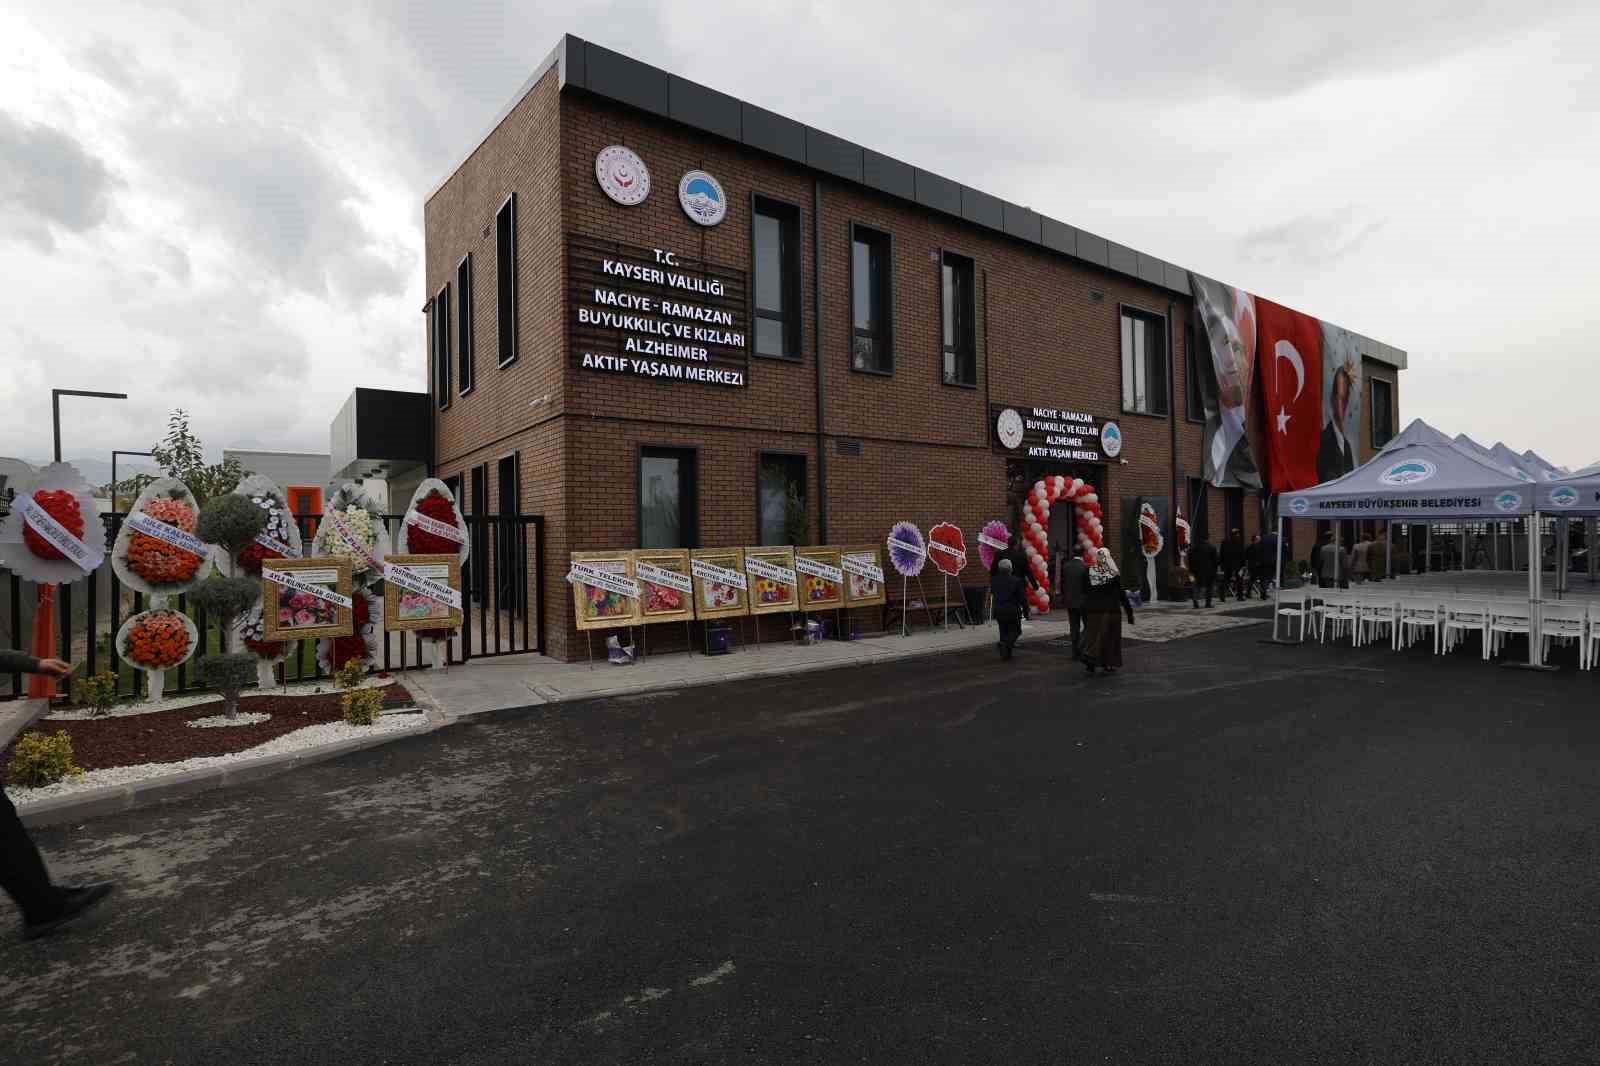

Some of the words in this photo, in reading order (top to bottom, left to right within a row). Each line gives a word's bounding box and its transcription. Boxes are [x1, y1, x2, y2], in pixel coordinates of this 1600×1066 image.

[654, 249, 680, 267] T.C.
[662, 301, 732, 326] RAMAZAN
[673, 323, 691, 339] VE
[631, 359, 682, 377] YAŞAM
[1061, 411, 1093, 422] RAMAZAN
